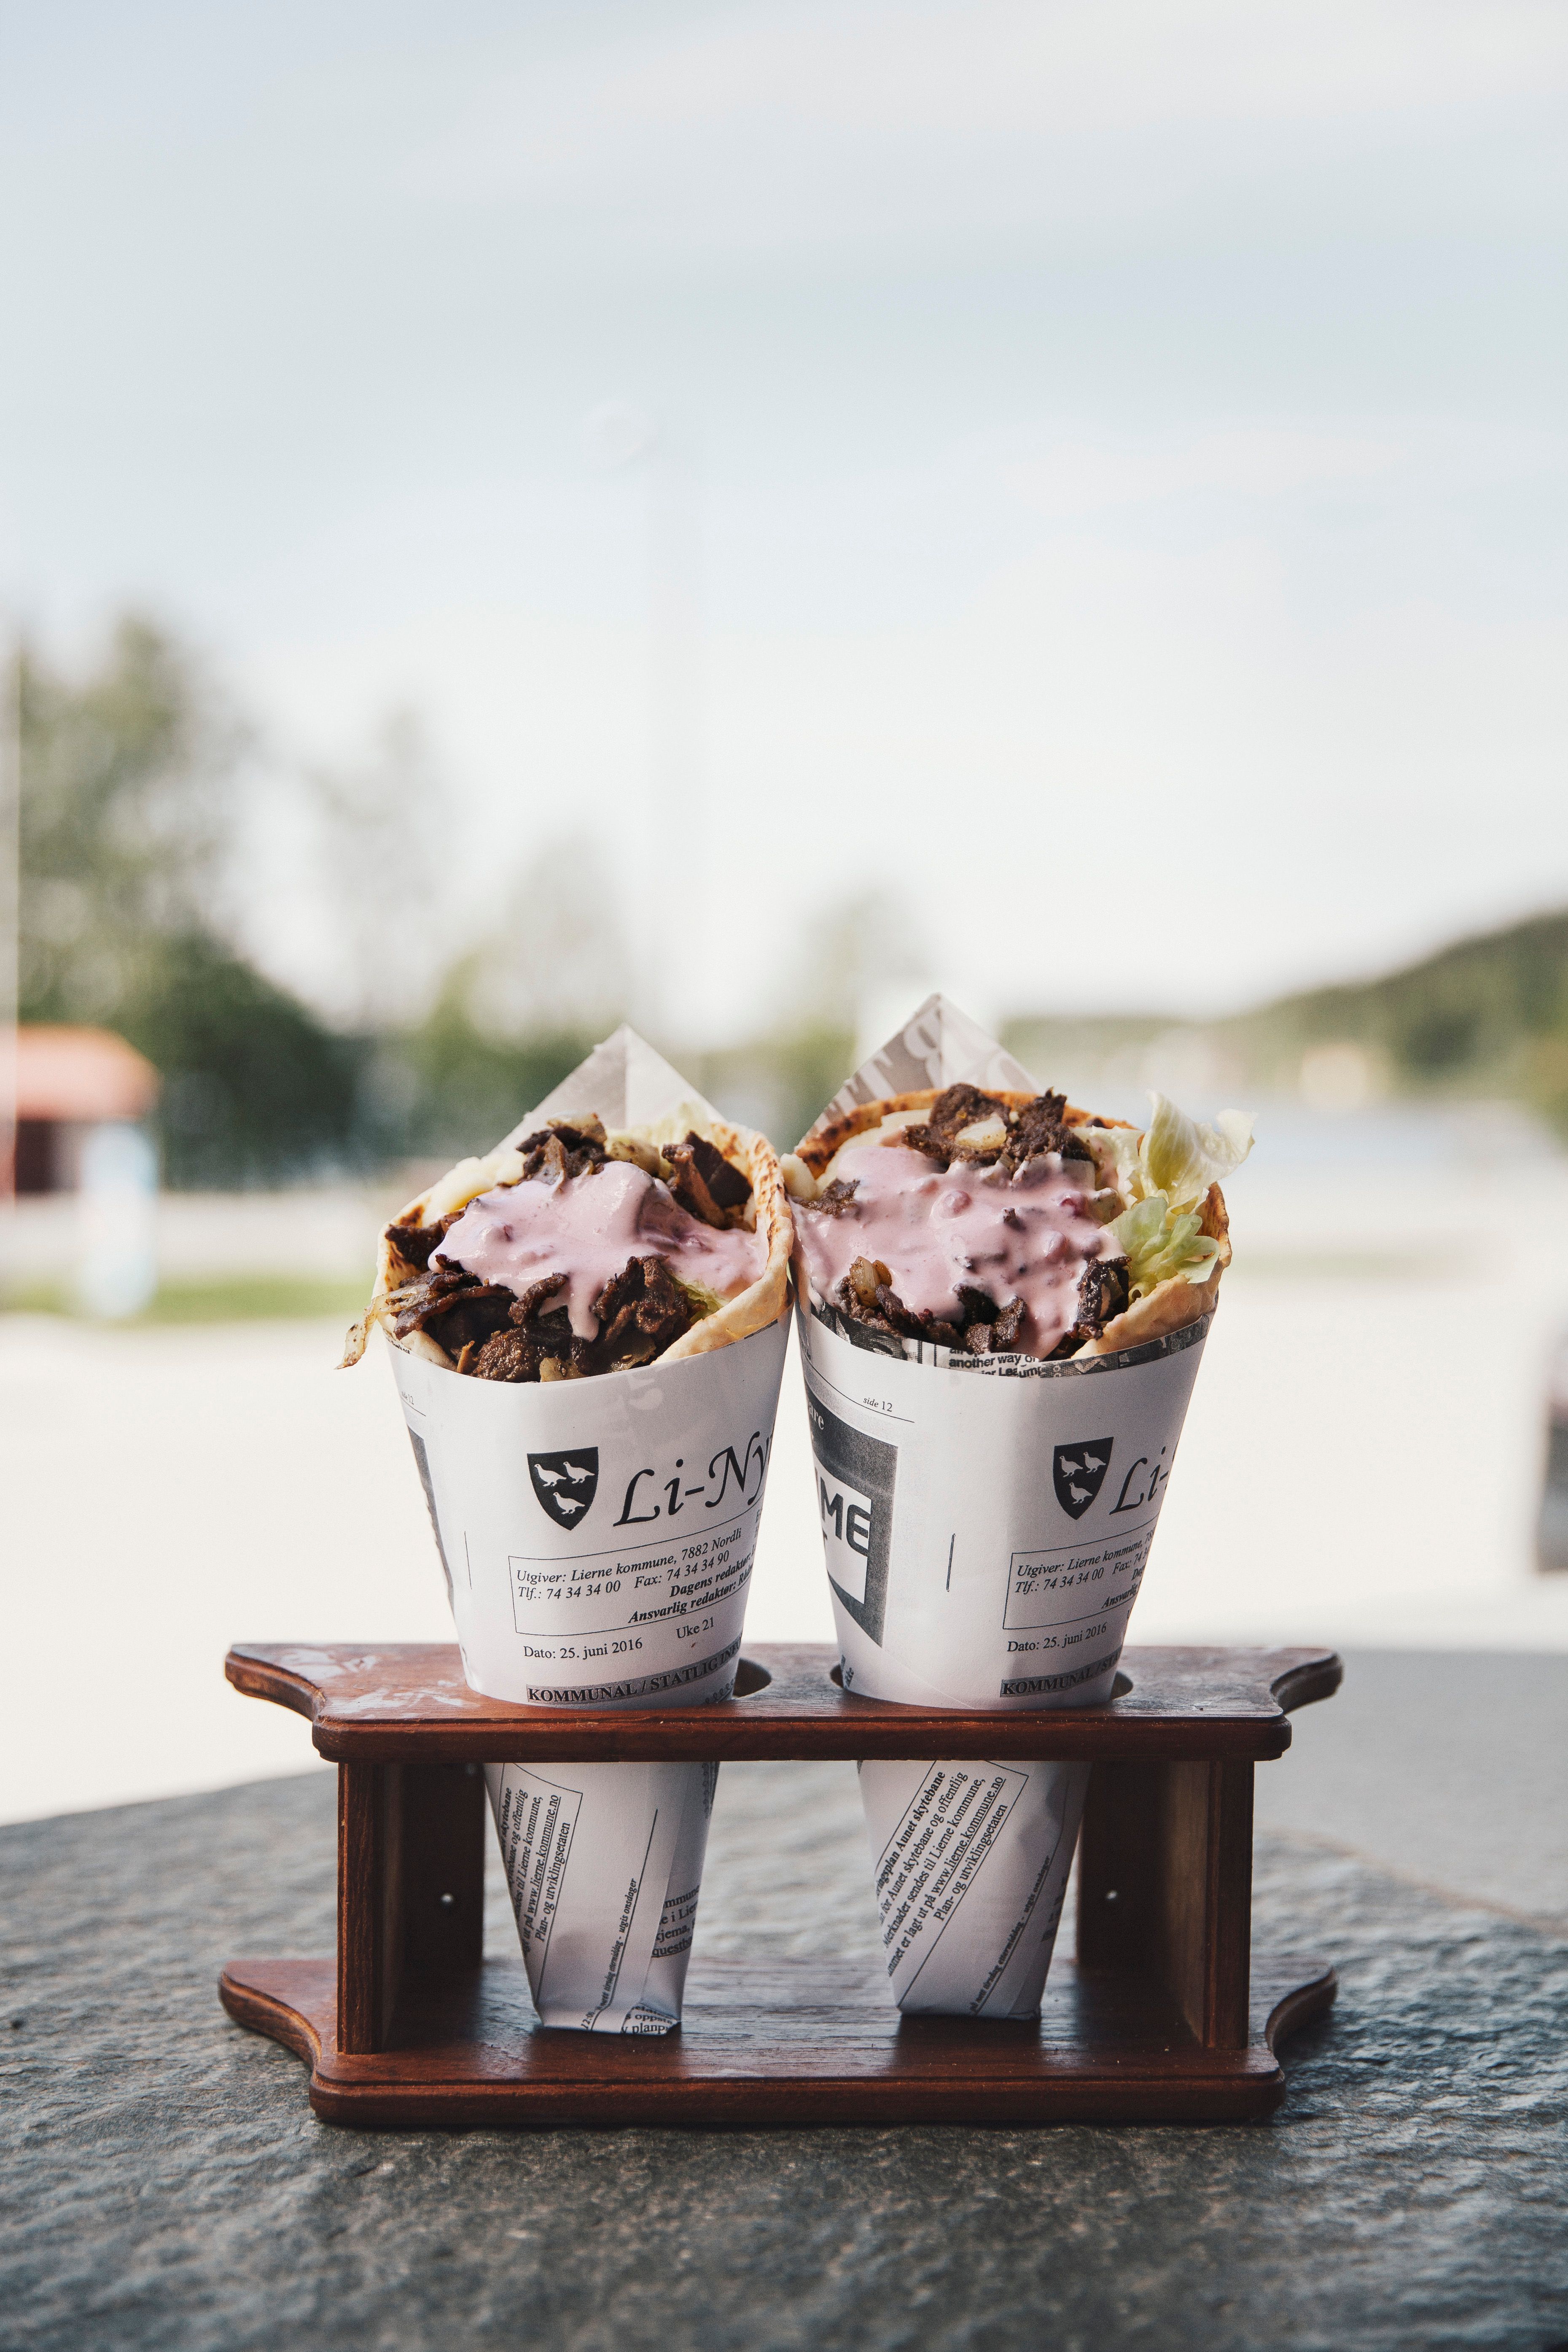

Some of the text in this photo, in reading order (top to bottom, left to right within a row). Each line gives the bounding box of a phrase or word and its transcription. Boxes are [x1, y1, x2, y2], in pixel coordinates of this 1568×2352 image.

[949, 1356, 995, 1369] another
[998, 1354, 1022, 1366] way
[863, 1397, 893, 1412] side 12
[613, 1431, 773, 1527] Li-Ny
[1109, 1446, 1175, 1515] Li-
[819, 1476, 871, 1558] ME
[517, 1570, 566, 1585] Utgiver:
[571, 1569, 612, 1581] Lierne
[616, 1555, 677, 1574] kommune,
[682, 1542, 708, 1561] 7882
[711, 1528, 741, 1551] Nordli
[518, 1550, 729, 1600] Tlf.: 74 34 34 00 Fax: 74 34 34 90
[1017, 1563, 1065, 1578] Utgiver:
[1067, 1555, 1101, 1571] Lierne
[1102, 1540, 1143, 1562] kommune,
[669, 1577, 713, 1597] Dagens
[1014, 1581, 1039, 1594] Tlf.:
[1044, 1578, 1058, 1590] 74
[1059, 1576, 1074, 1588] 34
[1076, 1573, 1089, 1585] 34
[1091, 1567, 1105, 1580] 00
[1112, 1560, 1133, 1574] Fax:
[628, 1601, 688, 1623] Ansvarlig
[691, 1581, 736, 1608] redaktør:
[676, 1616, 714, 1639] Uke 21
[1007, 1622, 1107, 1652] Dato: 25. juni 2016
[524, 1637, 643, 1660] Dato: 25. juni 2016
[528, 1682, 637, 1702] KOMMUNAL
[642, 1680, 646, 1693] /
[651, 1657, 718, 1690] STATLIG
[1002, 1667, 1094, 1694] KOMMUNAL
[512, 1789, 528, 1831] offentlig
[523, 1796, 543, 1846] kommune,
[896, 1820, 917, 1852] Aunet
[912, 1771, 945, 1822] skytebane
[947, 1779, 986, 1828] kommune,
[527, 1794, 559, 1914] www.lierne.kommune.no
[888, 1871, 908, 1901] Aunet
[903, 1827, 934, 1873] skytebane
[930, 1813, 944, 1827] og
[938, 1771, 968, 1814] offentlig
[929, 1827, 955, 1860] Lierne
[931, 1776, 1004, 1894] www.lierne.kommune.no
[517, 1846, 531, 1879] Lierne
[535, 1822, 570, 1943] Plan- og utviklingsetaten
[923, 1858, 936, 1871] til
[933, 1804, 1009, 1921] Plan- og utviklingsetaten
[619, 1914, 629, 1933] utgis
[624, 1878, 637, 1914] onsdager
[907, 1870, 930, 1903] sendes
[924, 1894, 936, 1910] på
[904, 1918, 923, 1938] lagt
[917, 1907, 929, 1919] ut
[901, 1936, 911, 1948] er
